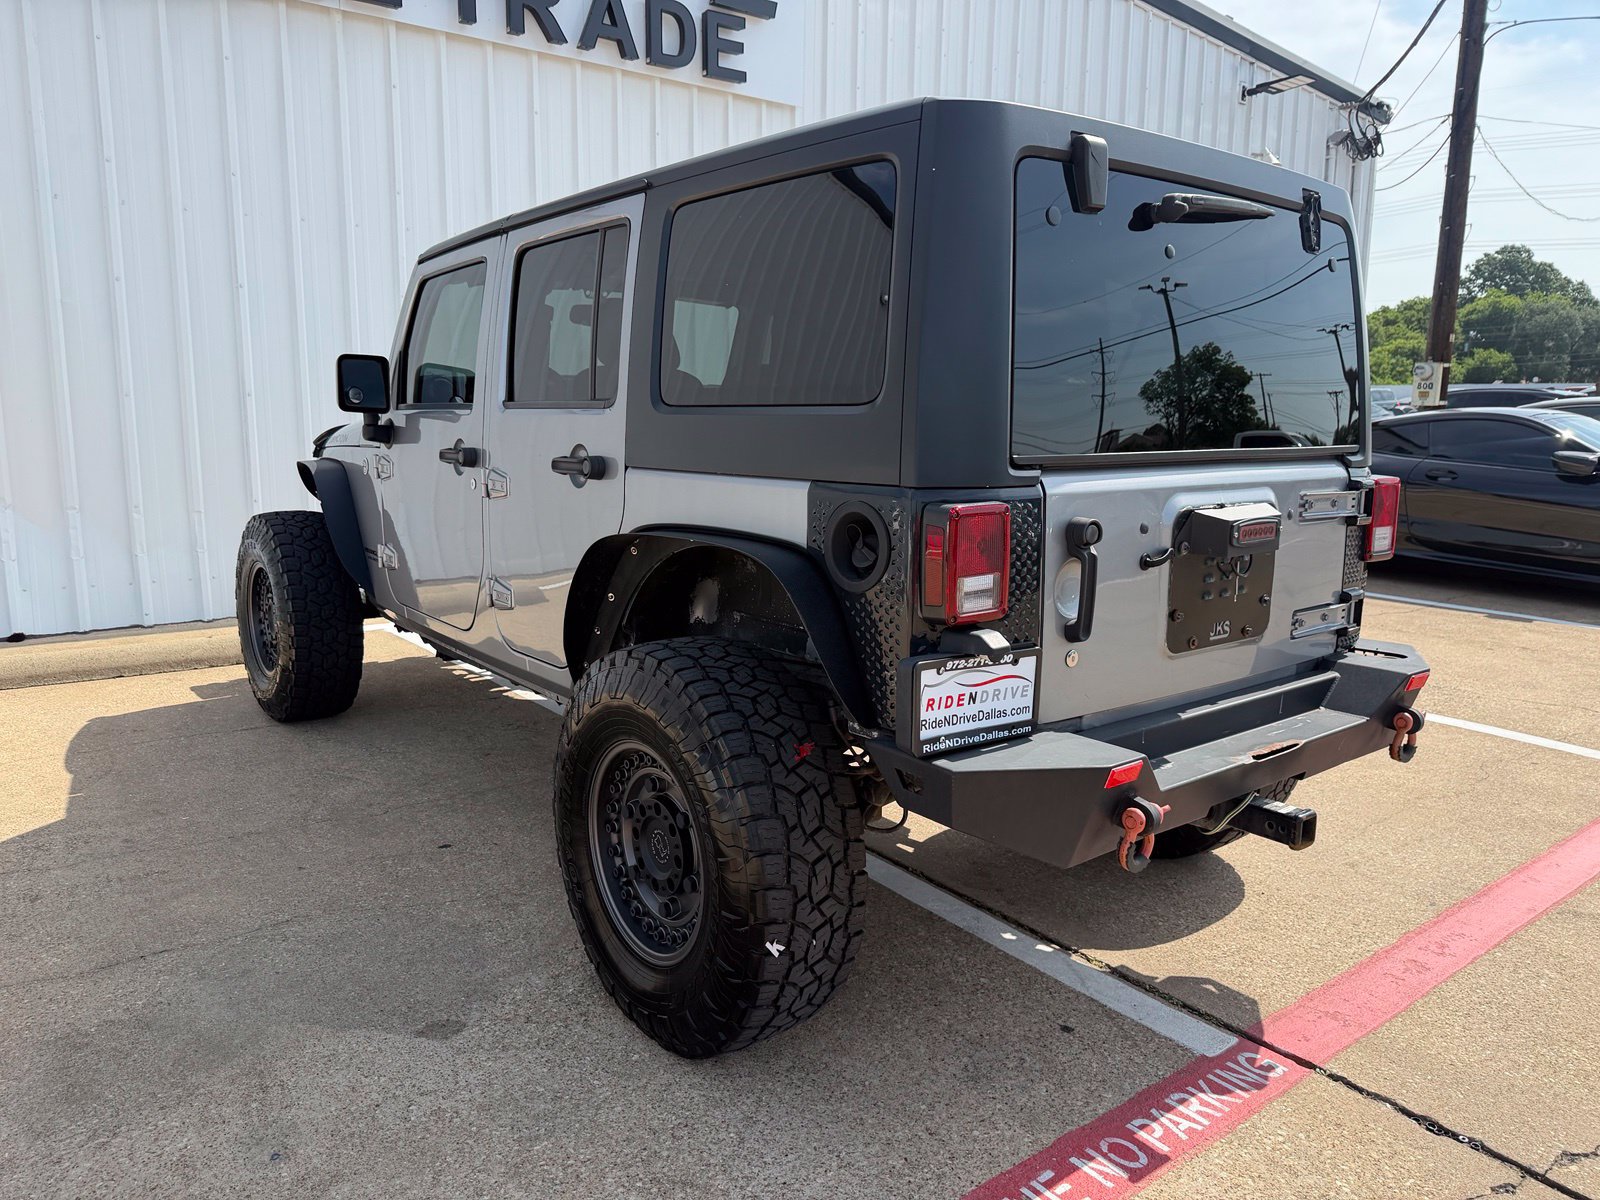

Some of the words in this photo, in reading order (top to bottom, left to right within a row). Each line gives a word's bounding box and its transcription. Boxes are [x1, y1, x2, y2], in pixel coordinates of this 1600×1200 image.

[1416, 382, 1434, 390] 800
[1209, 620, 1231, 640] JKS
[945, 653, 1014, 670] 972-271-00
[925, 684, 1030, 712] RIDENDRIVE
[920, 705, 1031, 732] RideNDriveDallas.com
[922, 725, 1032, 754] RideNDriveDallas.com
[1068, 1137, 1148, 1188] NO
[1125, 1052, 1289, 1152] PARKING
